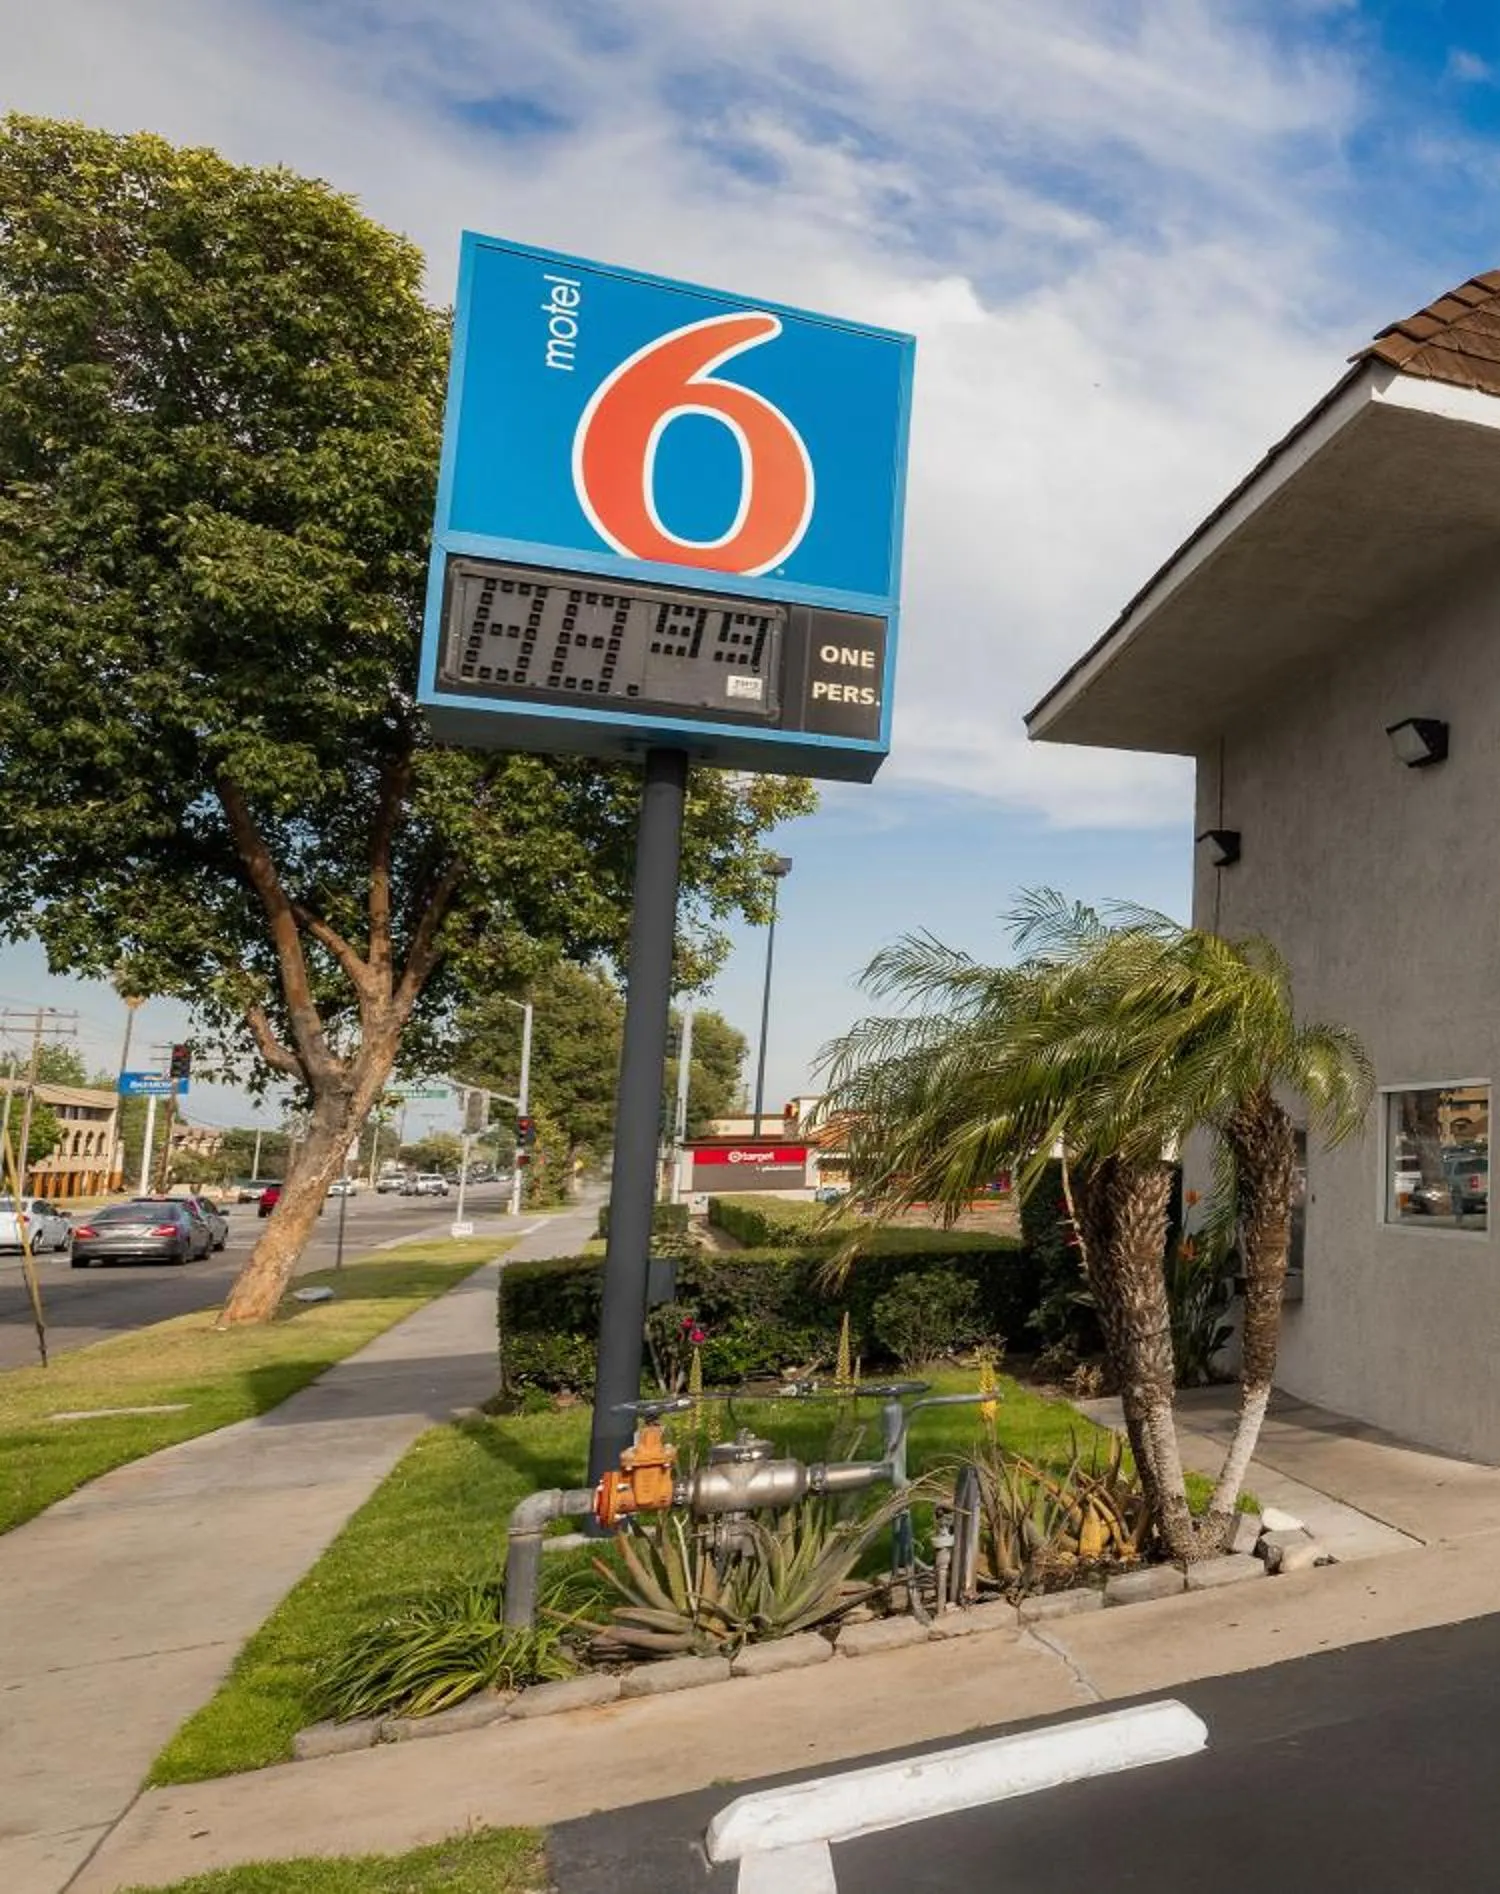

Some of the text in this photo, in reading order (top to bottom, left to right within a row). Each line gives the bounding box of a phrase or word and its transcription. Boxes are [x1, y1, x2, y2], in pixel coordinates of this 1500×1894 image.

[541, 274, 581, 371] motel
[571, 311, 815, 577] 6
[819, 645, 876, 669] ONE
[811, 681, 881, 706] PERS.
